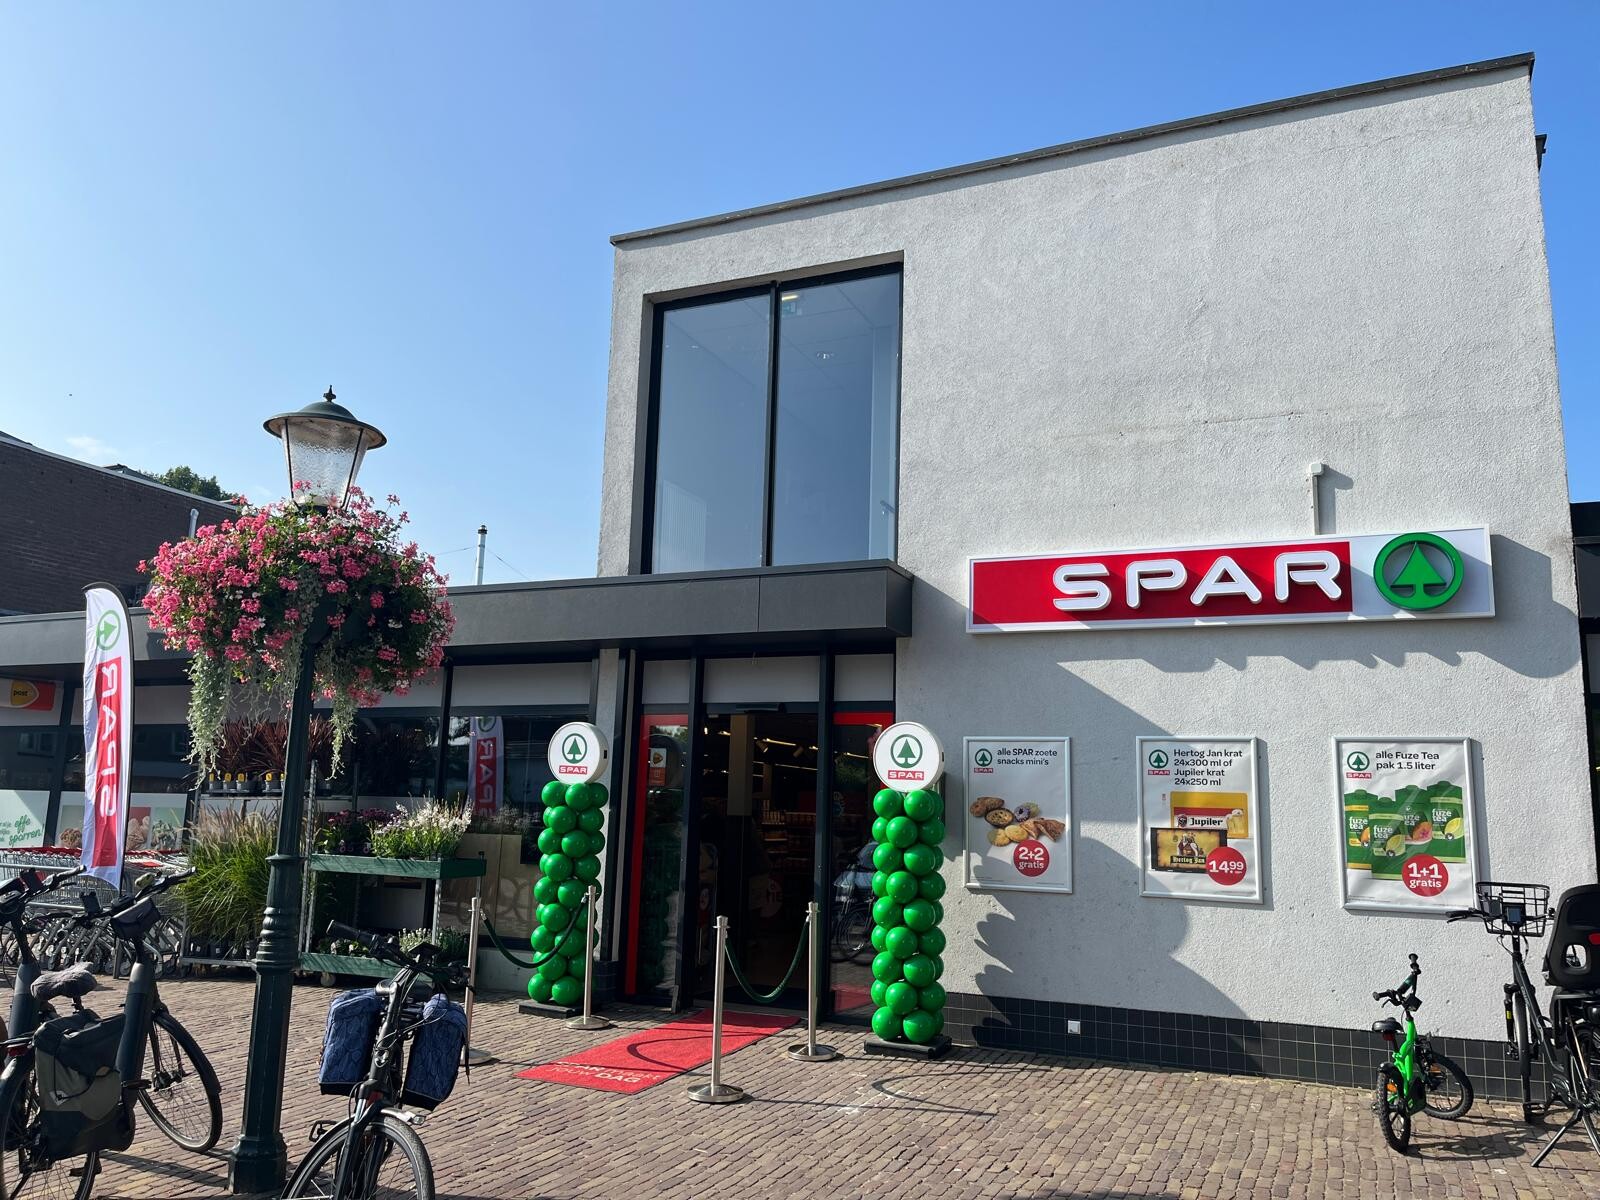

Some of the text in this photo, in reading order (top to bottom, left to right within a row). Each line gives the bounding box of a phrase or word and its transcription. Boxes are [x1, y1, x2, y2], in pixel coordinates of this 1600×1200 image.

[1053, 550, 1342, 611] SPAR
[997, 747, 1011, 756] alle
[1012, 748, 1034, 756] SPAR
[1173, 749, 1243, 759] Hertog Jan krat
[1375, 751, 1440, 760] alle Fuze Tea
[997, 757, 1049, 766] snacks mini's
[1173, 759, 1233, 767] 24x300 ml of
[1376, 761, 1436, 770] pak 1.5 liter
[560, 766, 587, 774] SPAR
[1174, 768, 1225, 777] Jupiler krat
[889, 771, 923, 780] SPAR
[1174, 778, 1222, 786] 24x250 ml
[1432, 808, 1452, 817] fuze
[1190, 817, 1223, 826] Jupiler
[1349, 816, 1368, 825] fuze
[1349, 822, 1364, 830] tea
[1373, 825, 1393, 834] fuze
[1018, 846, 1044, 860] 2+2
[1018, 860, 1044, 869] gratis
[1208, 860, 1244, 874] 14.99
[1407, 862, 1443, 879] 1+1
[1409, 878, 1442, 888] gratis
[594, 1072, 641, 1083] DAG
